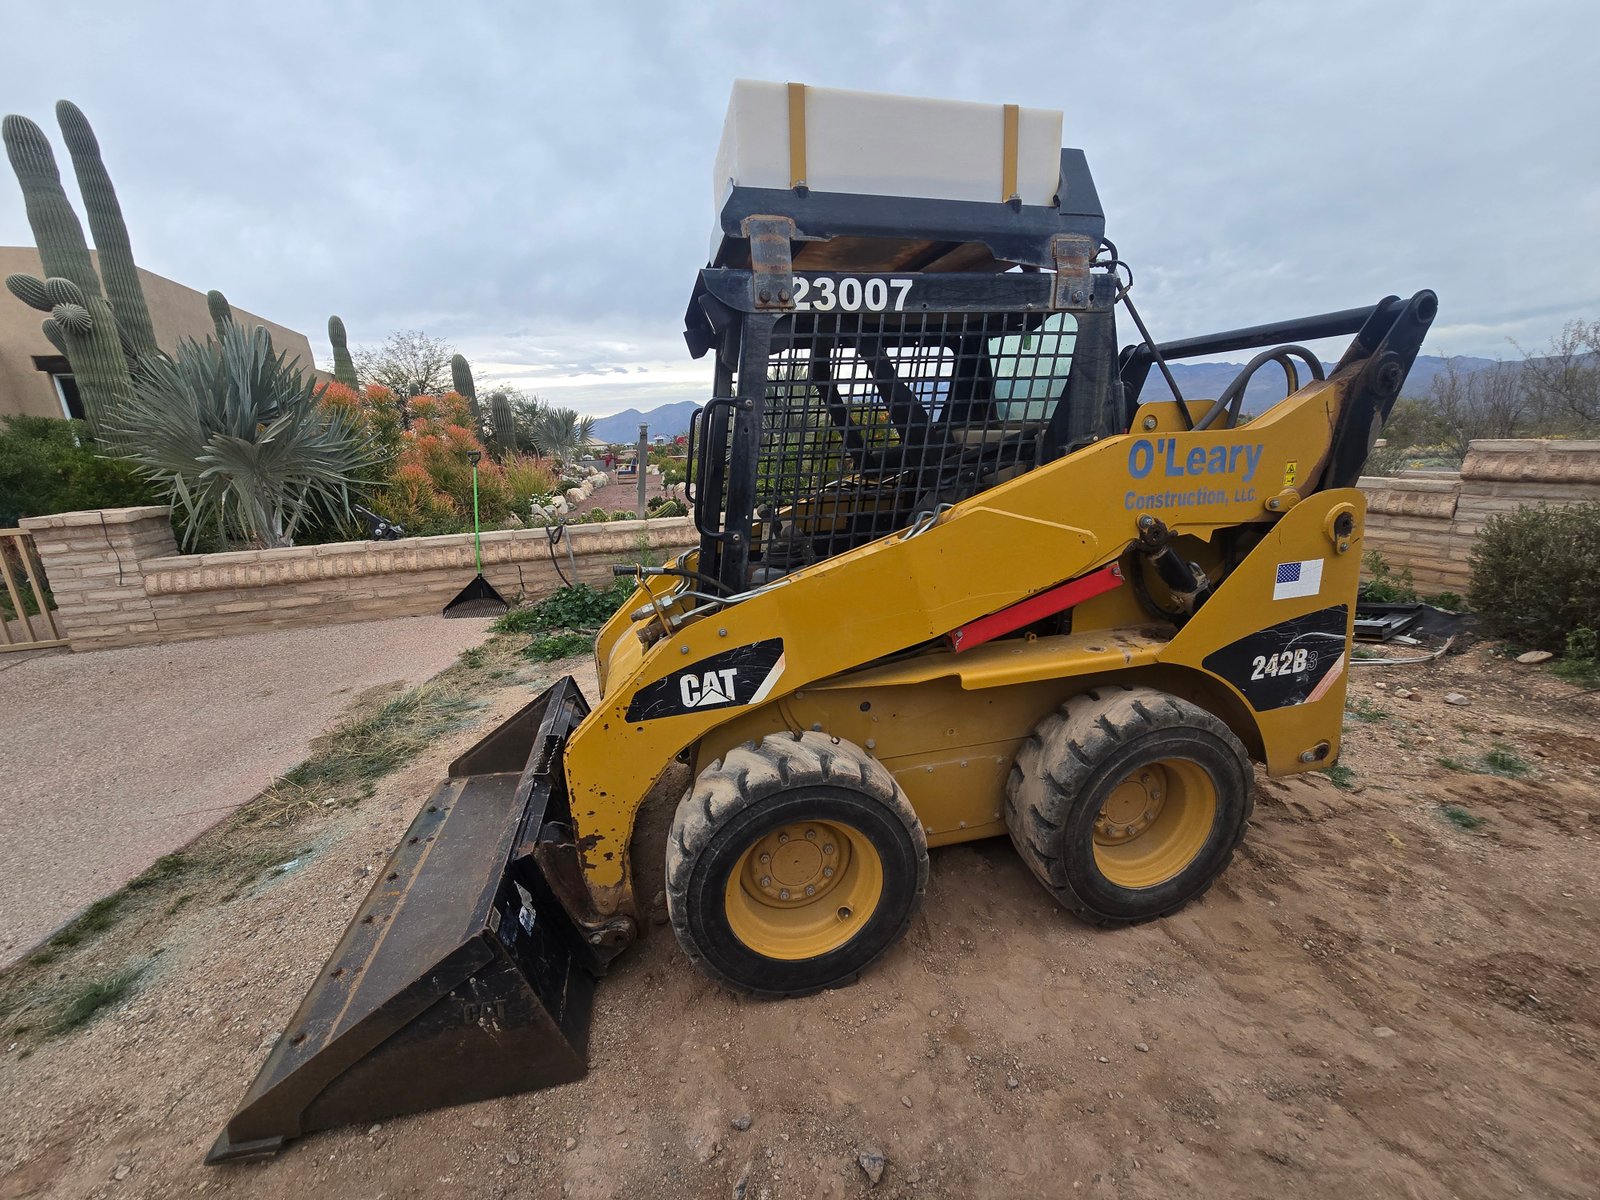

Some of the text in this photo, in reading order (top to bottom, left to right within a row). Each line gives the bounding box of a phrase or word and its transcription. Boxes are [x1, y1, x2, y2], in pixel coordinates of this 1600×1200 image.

[792, 277, 913, 311] 23007
[1127, 438, 1264, 483] O'Leary
[1124, 486, 1229, 511] Construction,
[679, 667, 737, 708] CAT
[463, 998, 507, 1025] CAT
